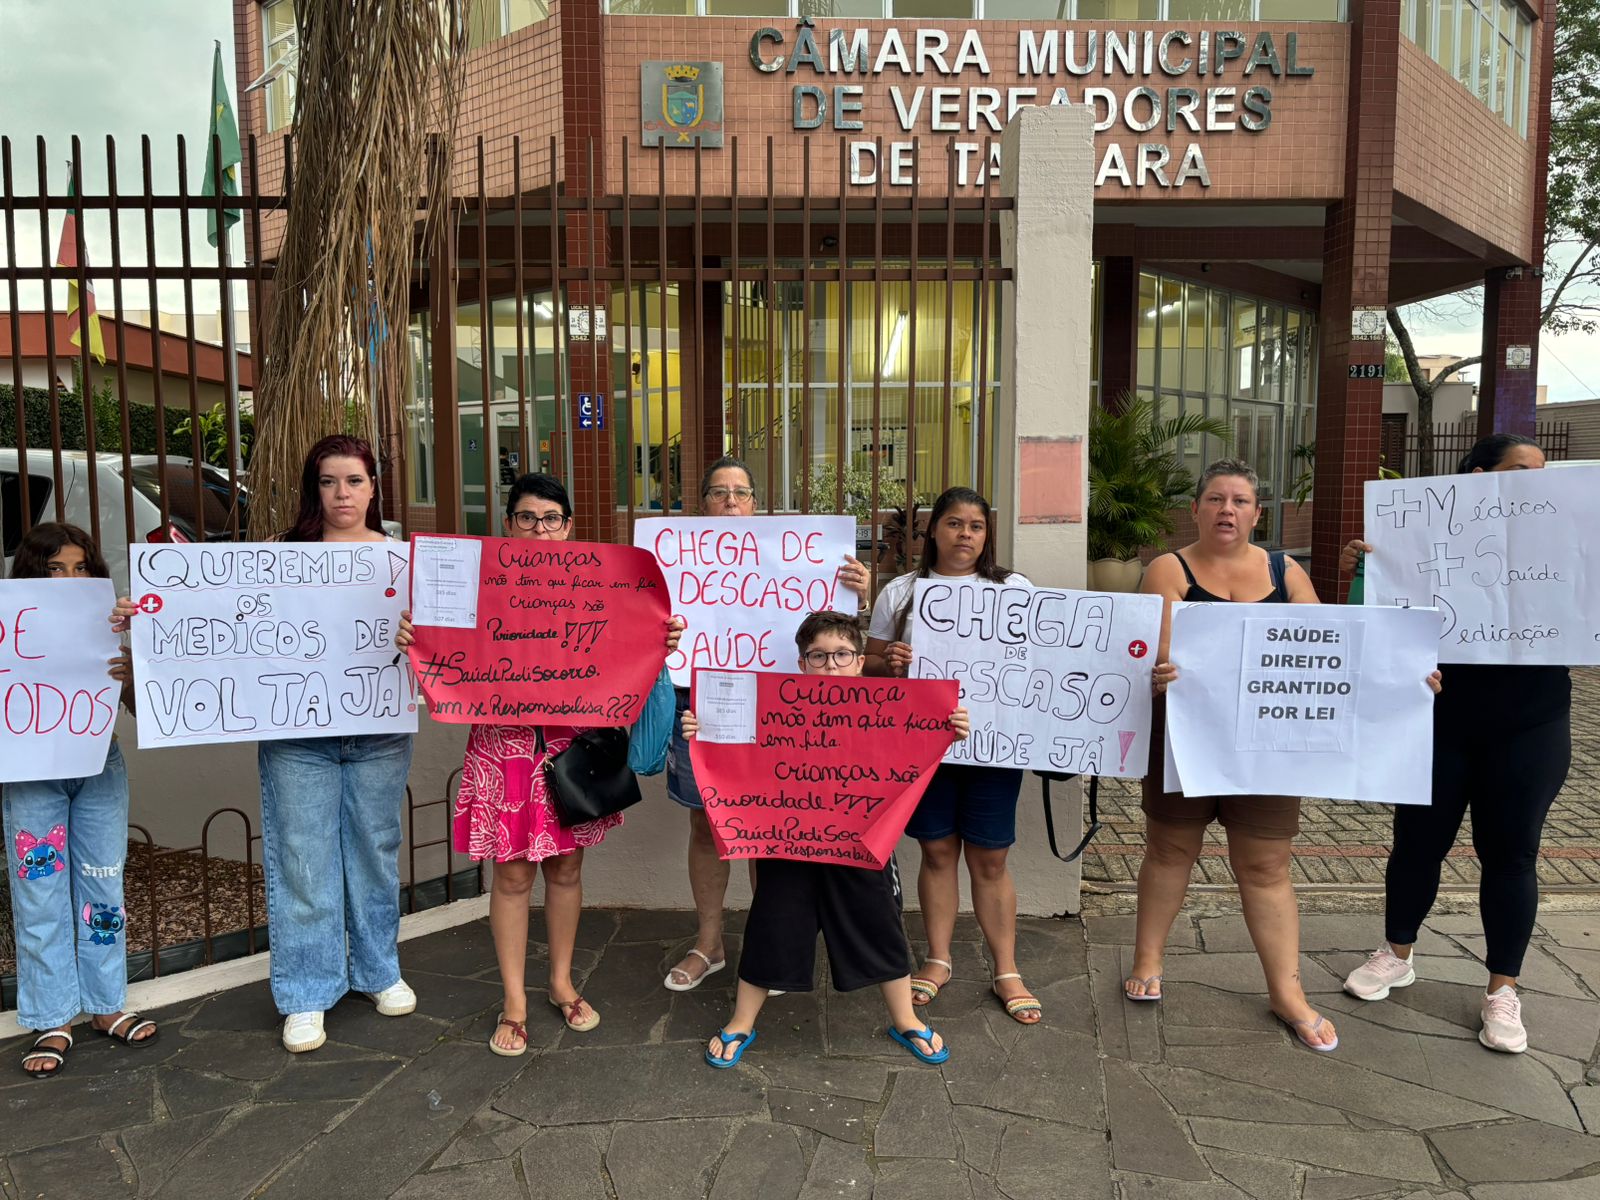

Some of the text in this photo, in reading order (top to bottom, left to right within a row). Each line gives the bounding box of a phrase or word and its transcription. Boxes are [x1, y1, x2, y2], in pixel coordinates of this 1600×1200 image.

[749, 16, 1315, 77] CÂMARA MUNICIPAL
[793, 85, 864, 131] DE
[850, 141, 1211, 187] DE TAARA
[1350, 365, 1384, 378] 2191
[498, 542, 602, 573] Crianças
[655, 528, 825, 568] CHEGA DE
[1471, 534, 1567, 588] Saúde
[515, 575, 542, 588] tem
[547, 578, 568, 593] que
[678, 566, 842, 613] DESCASO!
[355, 618, 391, 651] DE
[919, 584, 1114, 653] CHEGA
[1266, 626, 1340, 643] SAÚDE:
[1004, 646, 1028, 661] DE
[1260, 654, 1342, 669] DIREITO
[0, 668, 113, 737] ODOS
[779, 679, 906, 716] Criança
[1247, 680, 1351, 695] GRANTIDO
[812, 709, 853, 729] tem
[857, 715, 894, 733] que
[1258, 706, 1335, 720] POR LEI
[760, 737, 796, 748] em
[943, 721, 1035, 766] AÚDE
